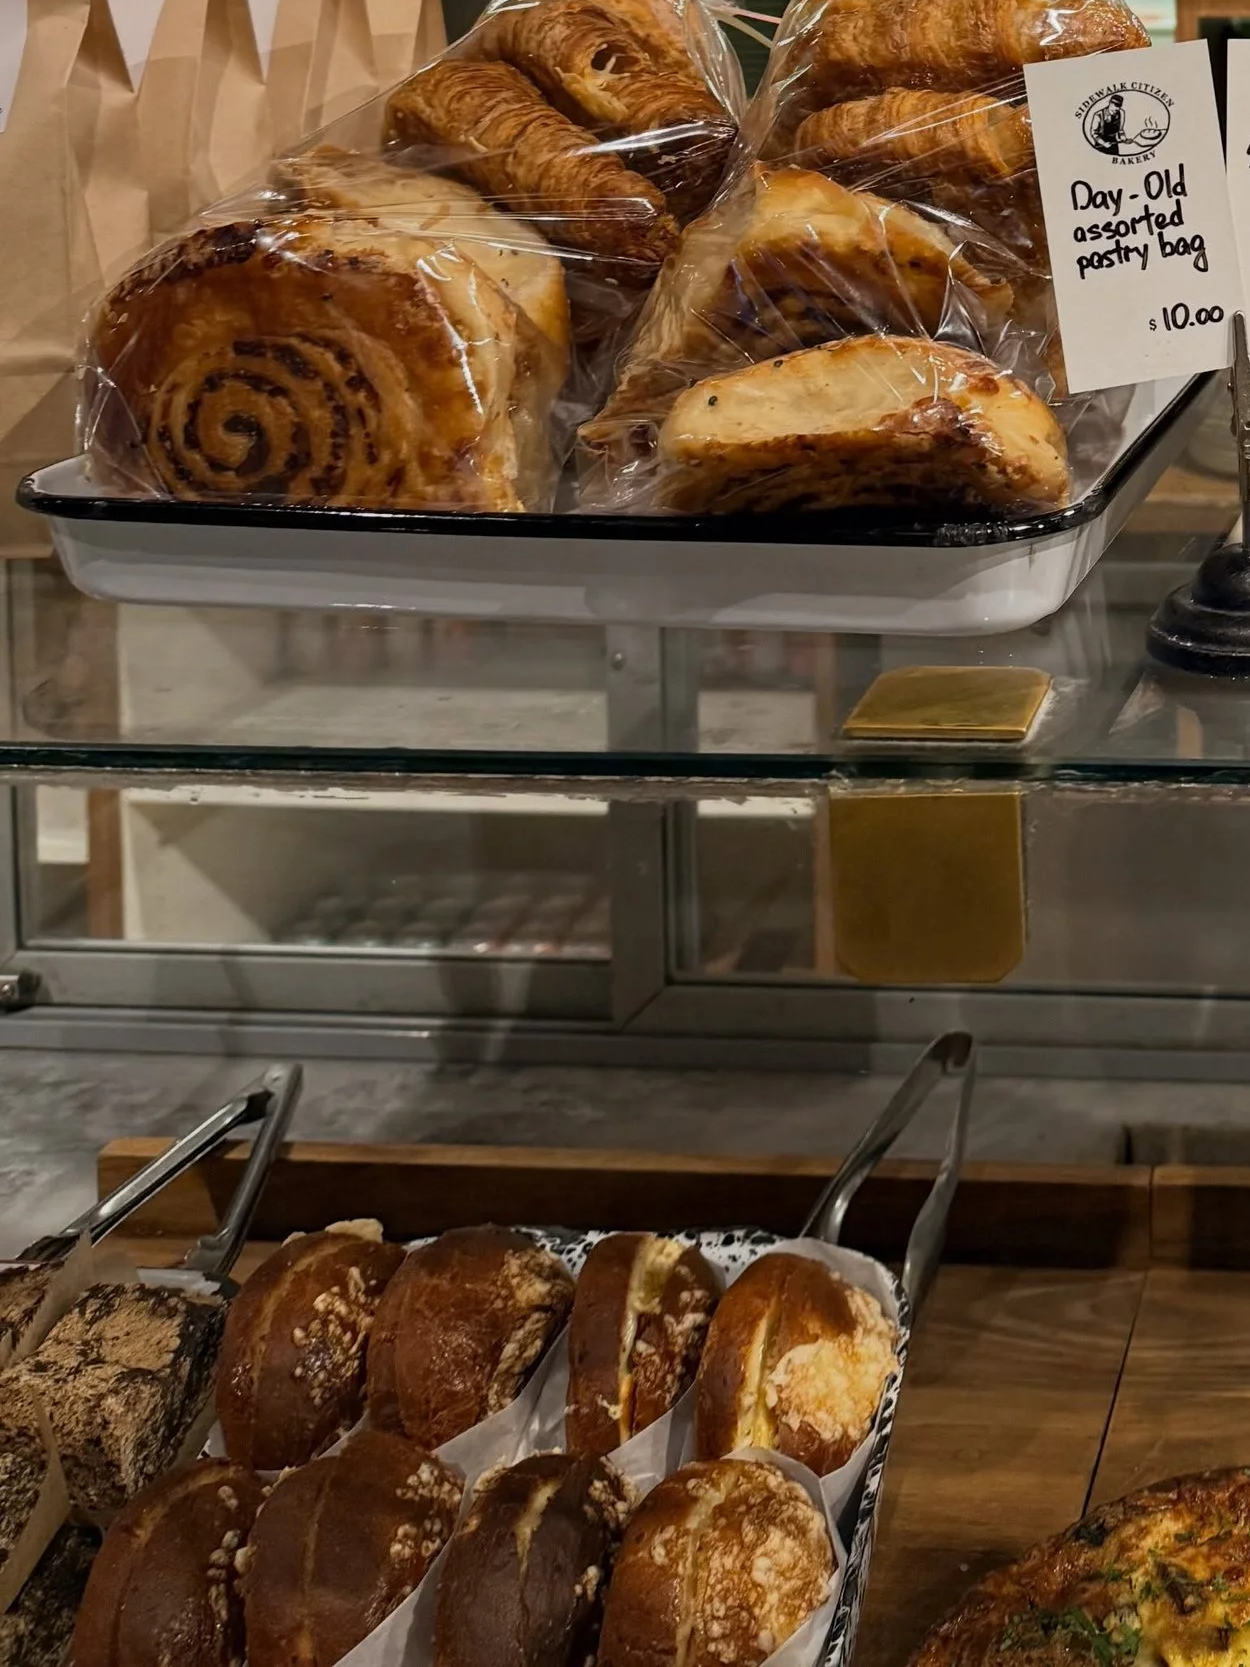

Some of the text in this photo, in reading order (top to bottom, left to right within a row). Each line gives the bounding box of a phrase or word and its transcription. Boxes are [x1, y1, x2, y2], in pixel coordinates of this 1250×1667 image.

[1075, 82, 1174, 119] SIDEWALK CITIZEN
[1112, 150, 1156, 165] BAKERY
[1073, 199, 1184, 244] assorted
[1076, 232, 1209, 279] pastry bag
